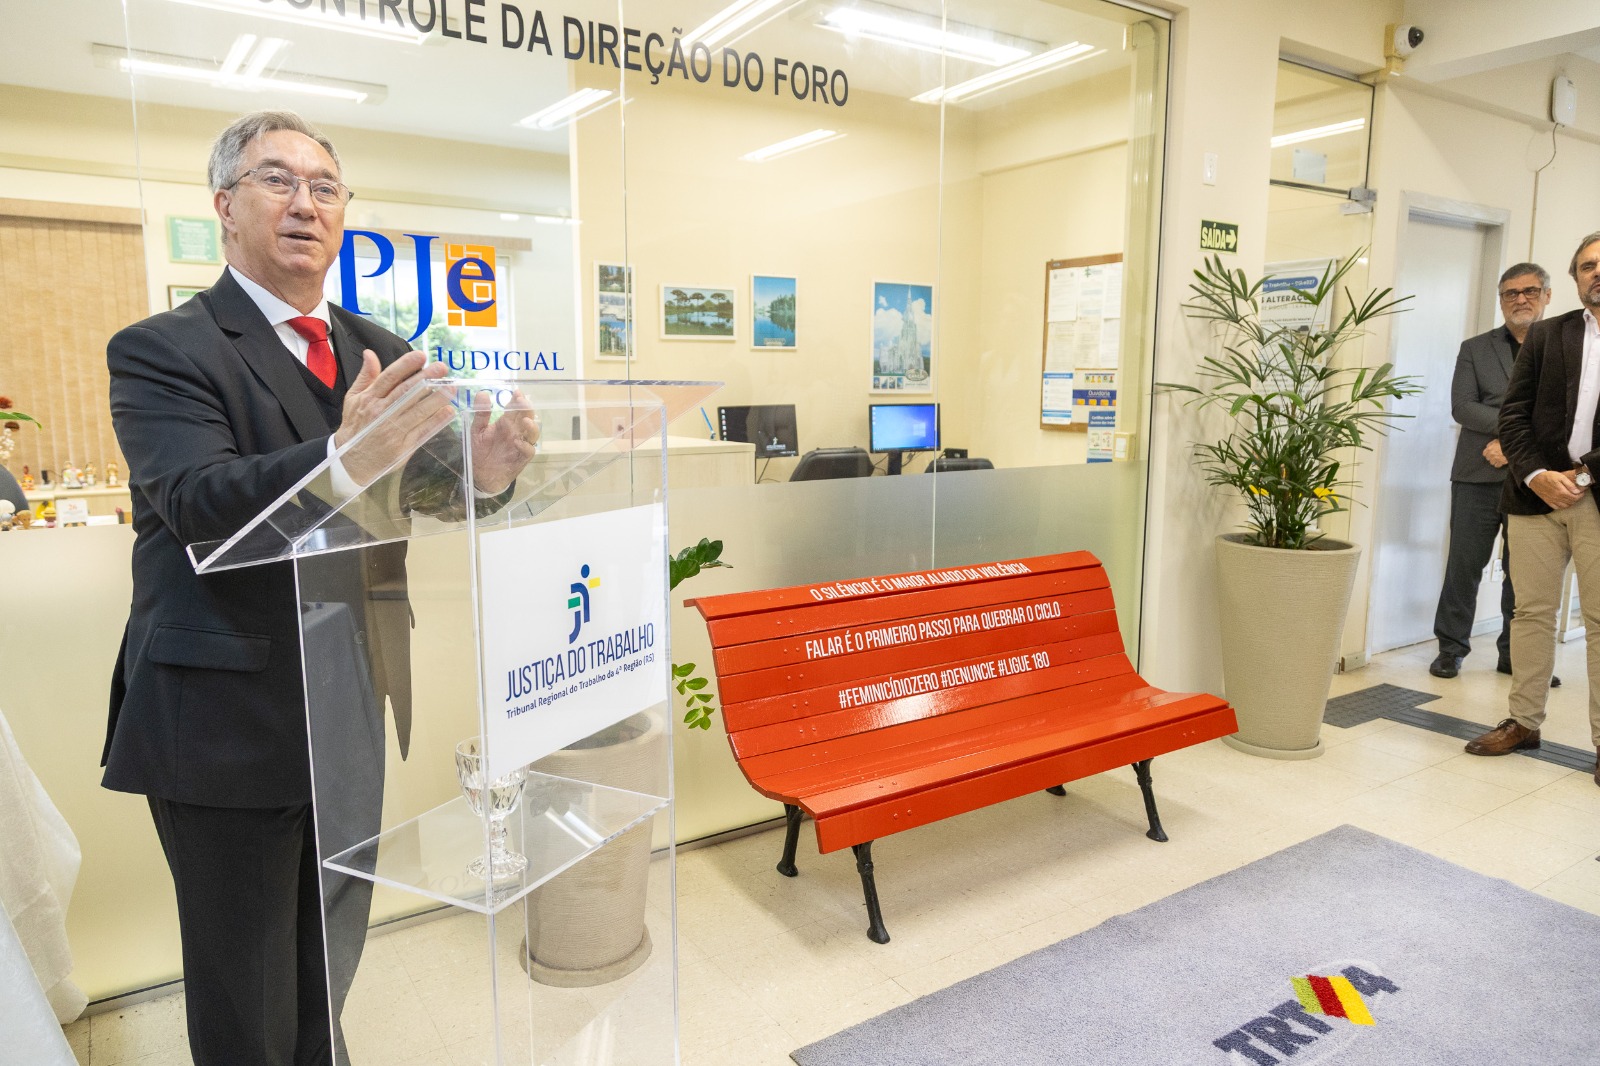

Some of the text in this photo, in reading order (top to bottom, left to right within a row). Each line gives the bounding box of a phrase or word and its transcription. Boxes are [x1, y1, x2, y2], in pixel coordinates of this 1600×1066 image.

[259, 0, 850, 107] ROLE DA DIREÇÃO DO FORO
[1201, 223, 1227, 250] SAÍDA
[1266, 293, 1318, 304] ALTERAÇ
[436, 346, 565, 372] JUDICIAL
[810, 562, 1032, 601] O SILÊNCIO É O MAIOR ALIADO DA VIOLÊNCIA
[805, 601, 1061, 660] FALAR É O PRIMEIRO PASSO PARA QUEBRAR O CICLO
[505, 622, 654, 702] JUSTIÇA DO TRABALHO
[506, 699, 537, 719] Tribunal
[538, 686, 569, 706] Regional
[569, 684, 578, 694] do
[579, 674, 606, 690] Trabalho
[607, 669, 615, 679] da
[623, 658, 643, 673] Região
[643, 652, 655, 666] (RS)
[838, 651, 1050, 709] #FEMINICÍDIOZERO #DENUNCIE #LIGUE 180
